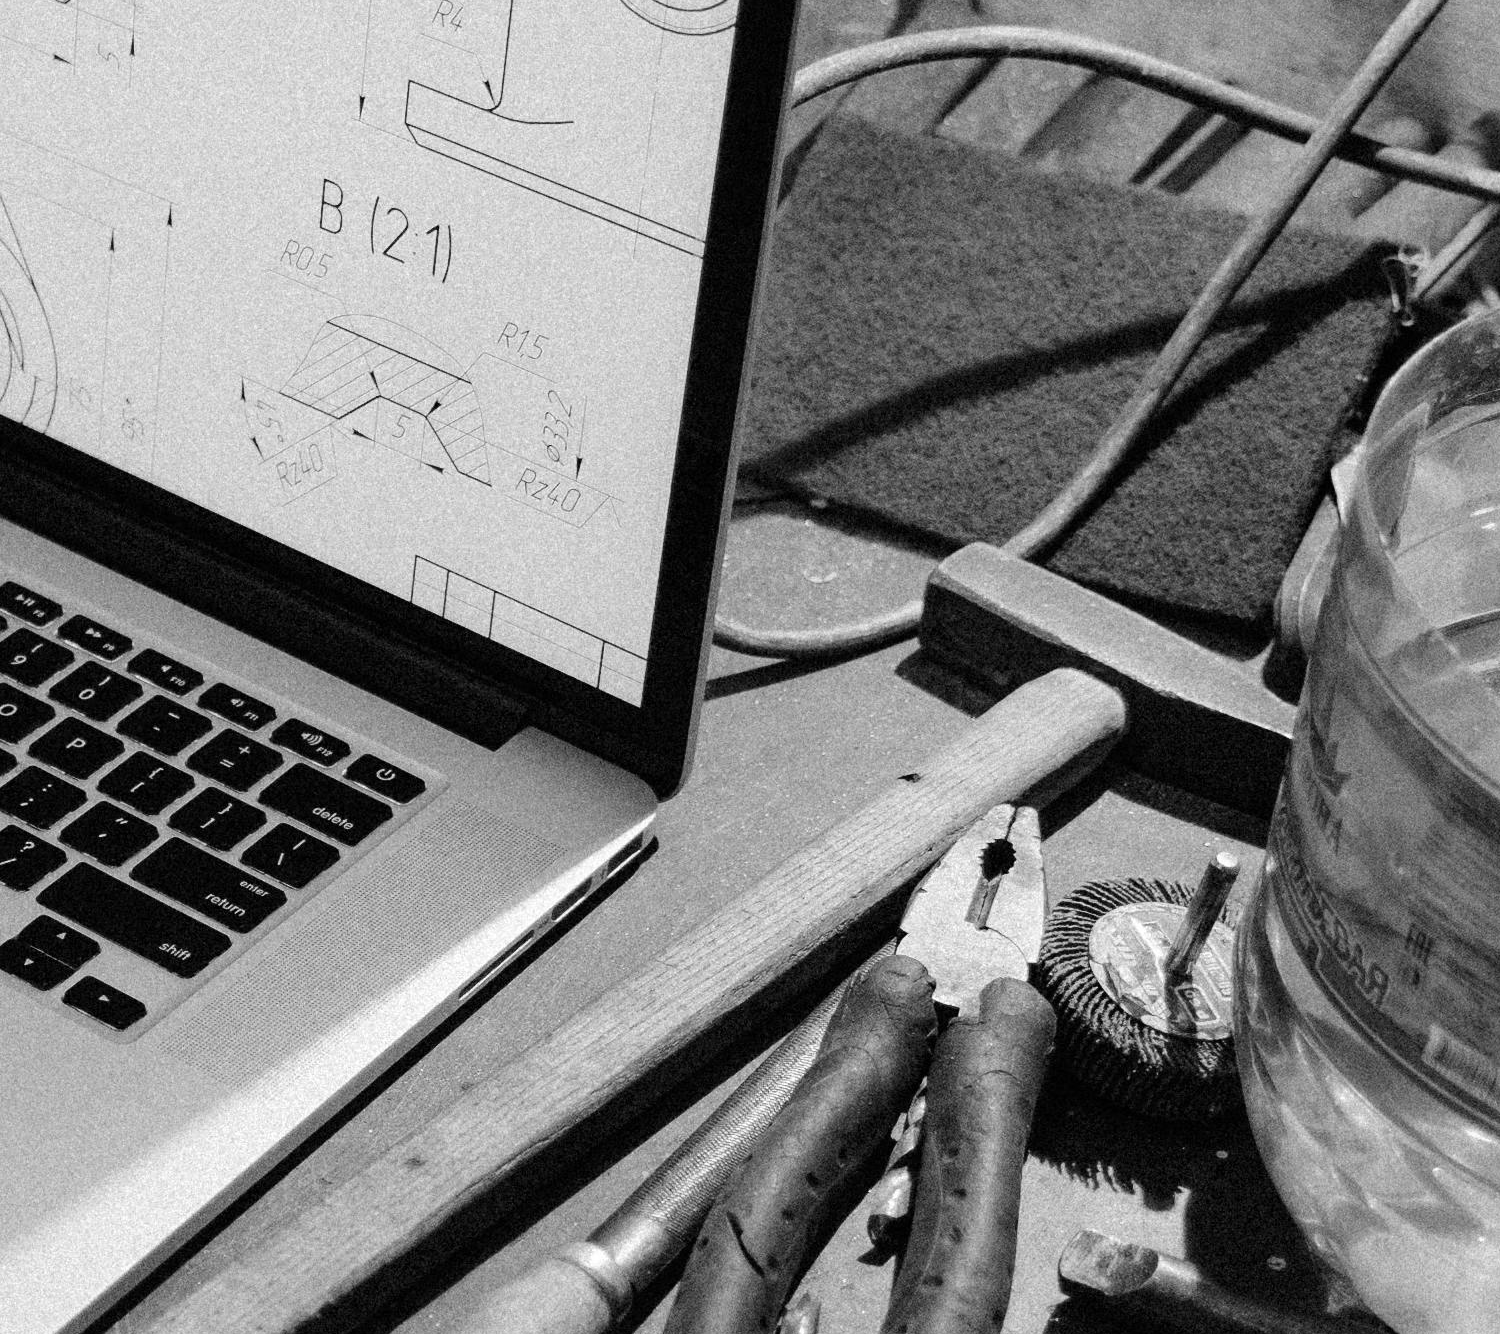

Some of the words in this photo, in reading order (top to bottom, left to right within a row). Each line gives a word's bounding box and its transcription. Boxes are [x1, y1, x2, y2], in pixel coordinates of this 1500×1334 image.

[390, 412, 413, 440] 5
[515, 466, 583, 514] Rz40
[11, 655, 27, 665] 9
[79, 688, 95, 700] 0
[66, 738, 86, 748] P
[311, 806, 354, 832] delete
[20, 841, 35, 852] ?
[239, 876, 270, 897] enter
[204, 893, 246, 918] return
[159, 943, 191, 960] shift
